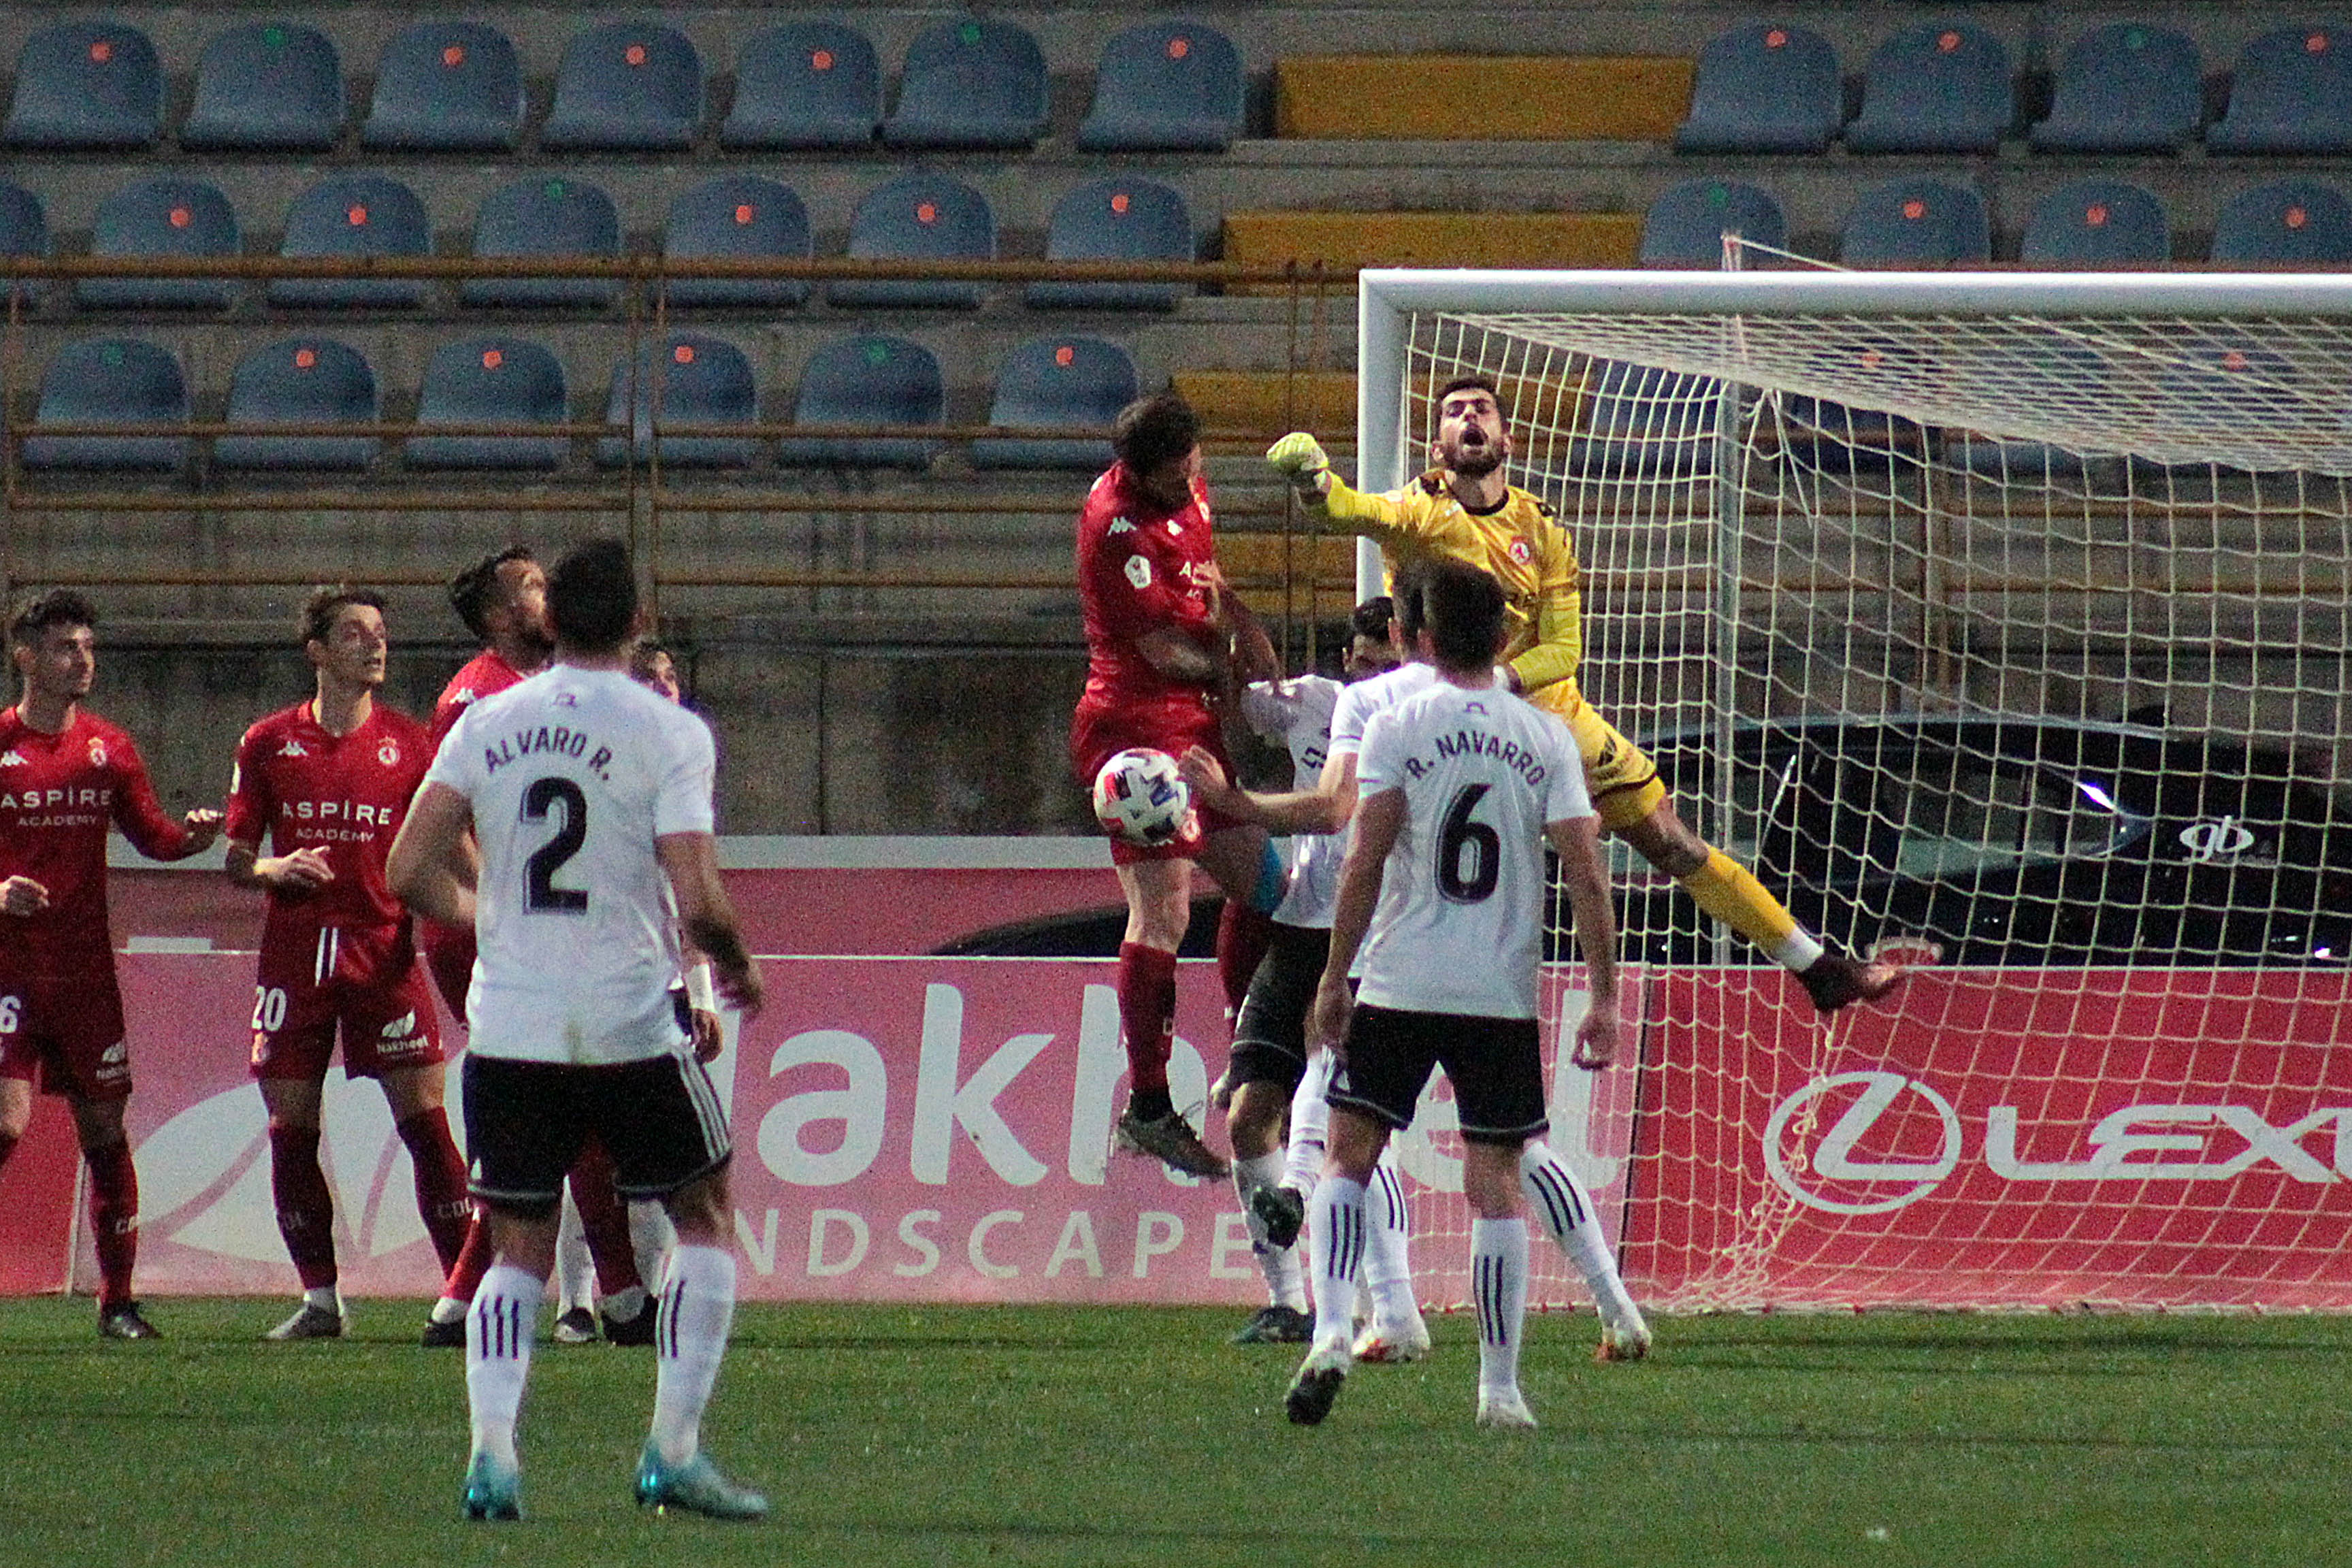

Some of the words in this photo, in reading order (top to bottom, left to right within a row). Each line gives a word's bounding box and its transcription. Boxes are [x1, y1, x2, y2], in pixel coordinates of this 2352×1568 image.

[485, 725, 587, 774] ALVARO
[588, 746, 612, 781] R.
[1405, 757, 1435, 780] R.
[1436, 732, 1546, 786] NAVARRO
[1, 785, 112, 808] ASPIRE
[18, 815, 97, 827] ACADEMY
[282, 800, 393, 828] ASPIRE
[295, 828, 374, 843] ACADEMY
[520, 777, 588, 916] 2
[1434, 783, 1500, 906] 6
[251, 985, 287, 1032] 20
[1985, 1104, 2352, 1184] LEX
